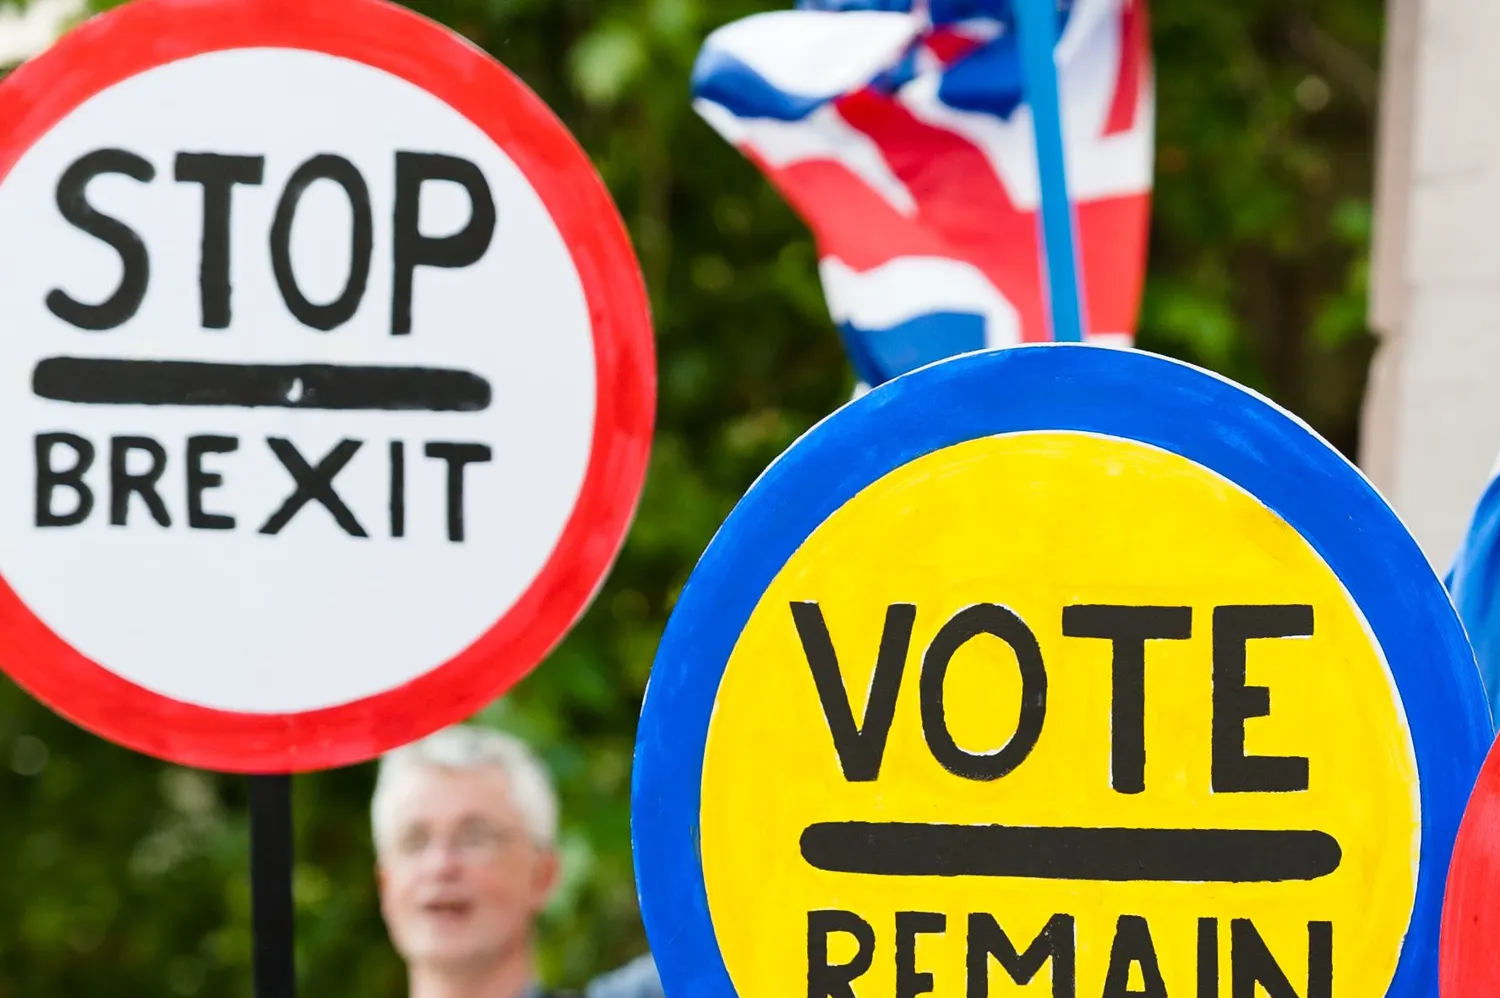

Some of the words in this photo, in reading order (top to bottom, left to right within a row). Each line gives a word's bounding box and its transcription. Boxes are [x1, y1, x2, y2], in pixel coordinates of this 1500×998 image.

[45, 148, 497, 336] STOP
[33, 431, 493, 542] BREXIT
[789, 600, 1314, 794] VOTE
